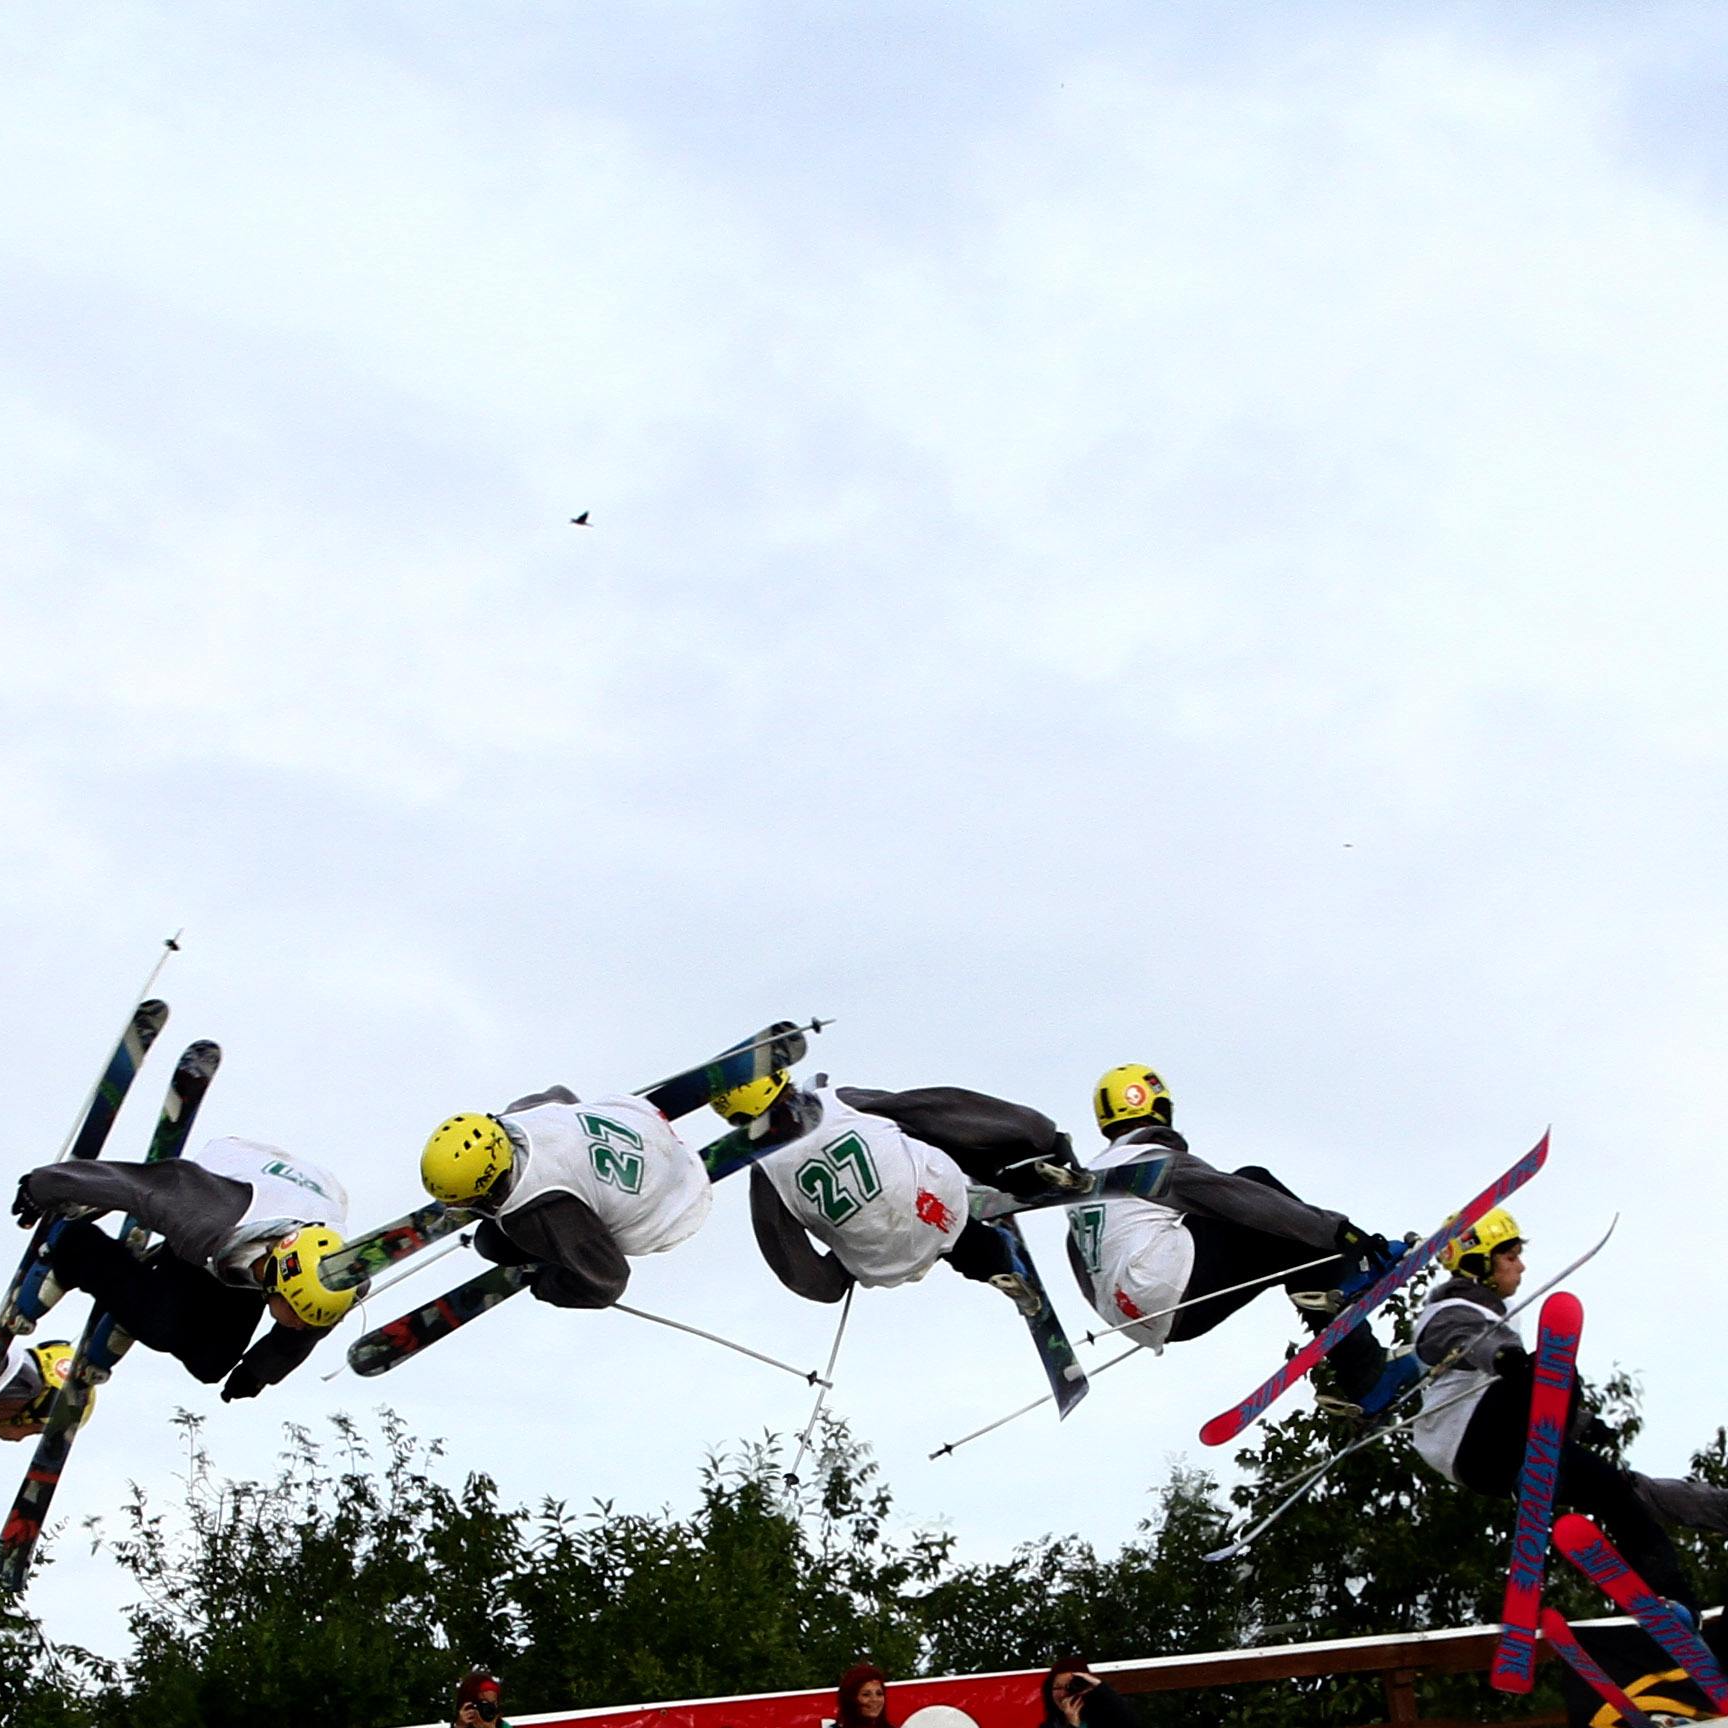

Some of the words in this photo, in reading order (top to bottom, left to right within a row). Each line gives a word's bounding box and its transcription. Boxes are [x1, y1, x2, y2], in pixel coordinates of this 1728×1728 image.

[576, 1111, 645, 1195] 27
[795, 1129, 883, 1228] 27
[1536, 1327, 1576, 1391] LINE
[1569, 1539, 1631, 1585] LINE
[1496, 1622, 1535, 1681] LINE
